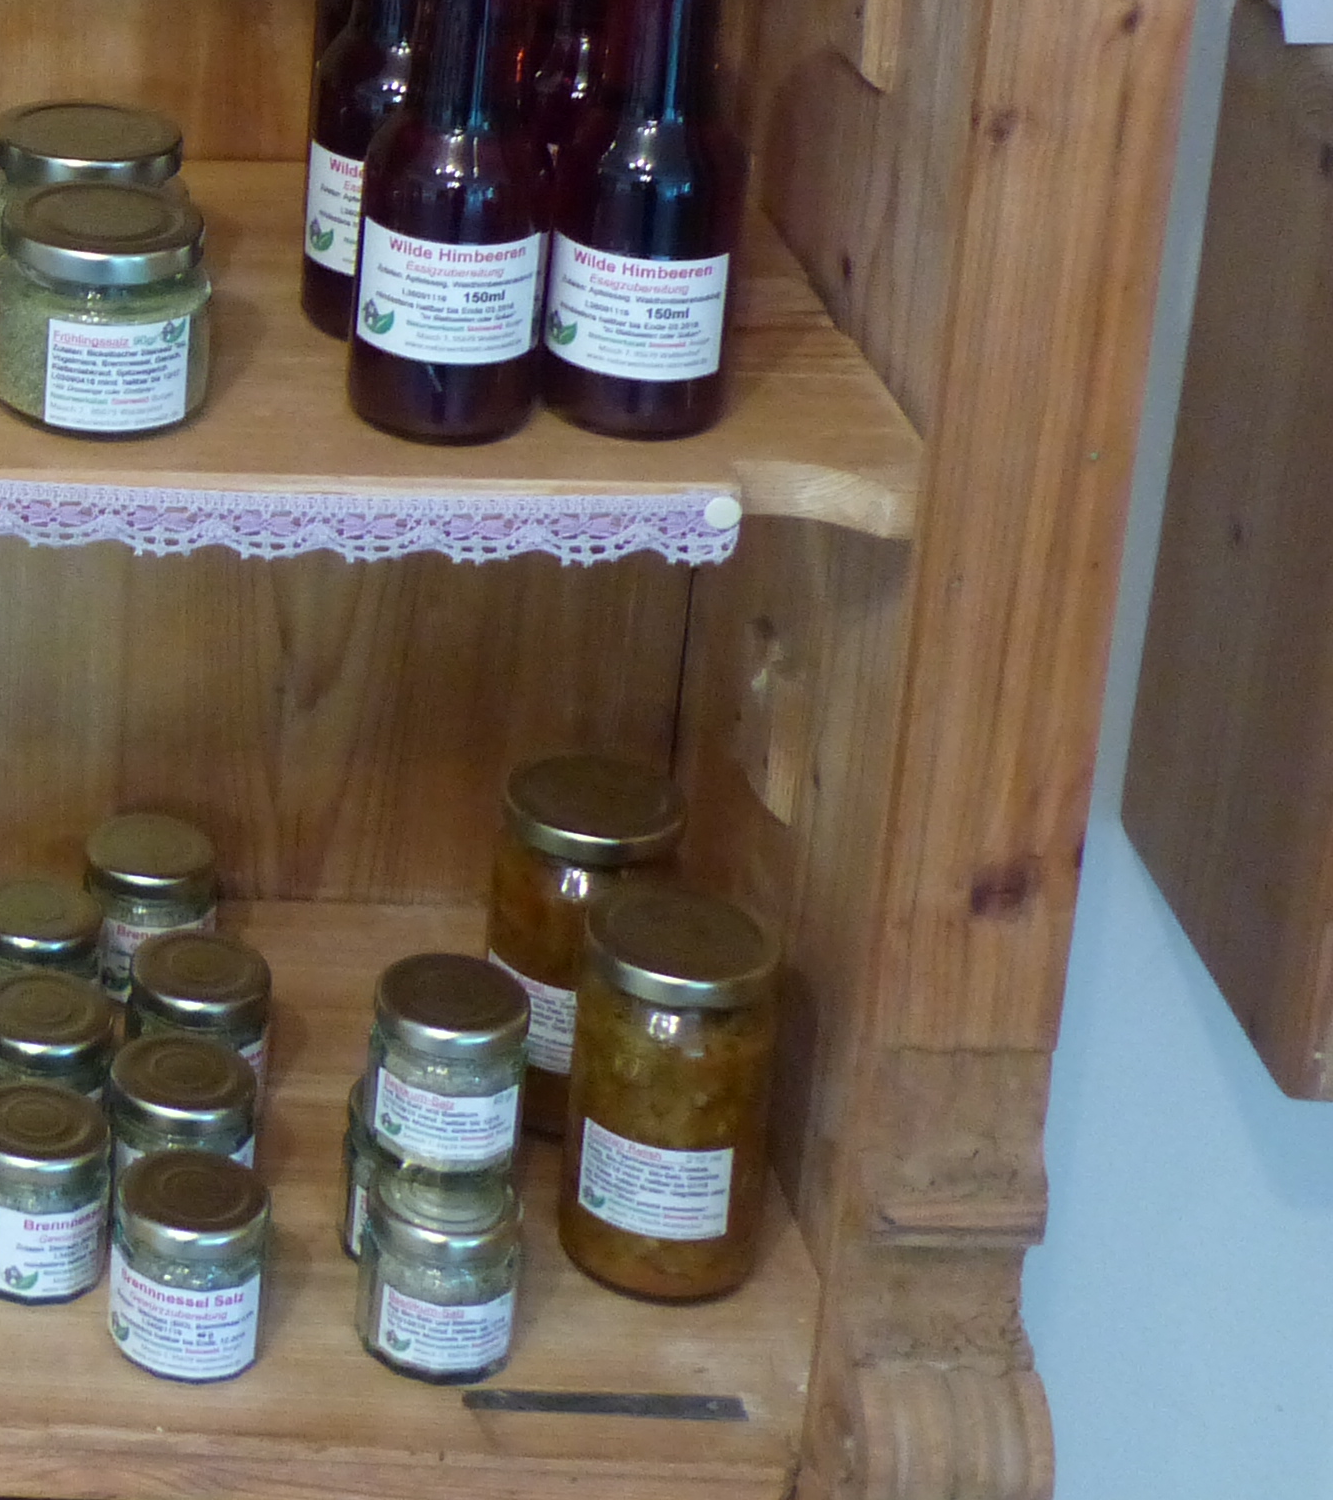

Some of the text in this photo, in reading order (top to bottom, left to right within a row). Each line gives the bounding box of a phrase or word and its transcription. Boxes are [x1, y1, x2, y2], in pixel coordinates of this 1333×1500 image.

[389, 237, 526, 263] Wilde Himbeeren
[574, 248, 713, 279] Wilde Himbeeren
[590, 274, 689, 295] Essigzubereitung
[464, 291, 505, 303] 150ml
[646, 308, 690, 319] 150ml
[53, 330, 129, 348] Frühlingssalz
[215, 1292, 244, 1307] Salz
